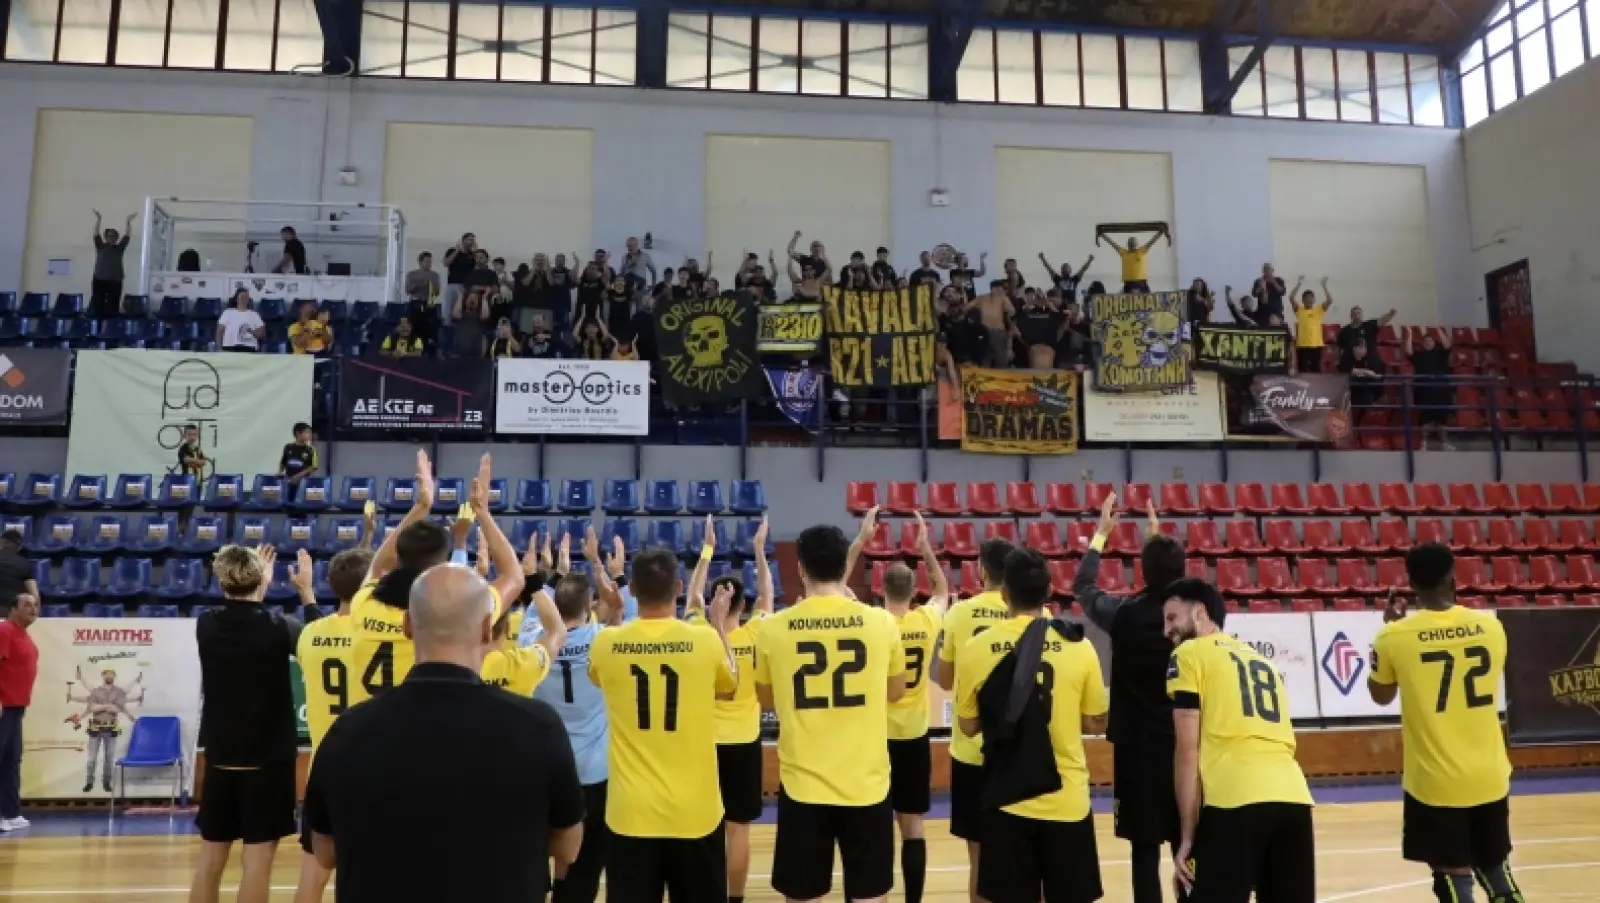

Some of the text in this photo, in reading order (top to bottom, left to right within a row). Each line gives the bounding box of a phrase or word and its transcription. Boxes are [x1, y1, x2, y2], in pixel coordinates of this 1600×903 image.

[660, 297, 746, 331] ORIGINAL
[504, 380, 641, 397] master optics
[788, 615, 864, 631] KOUKOULAS
[1418, 624, 1485, 642] CHICOLA
[362, 641, 394, 695] 4
[612, 641, 694, 655] PAPADIONYSIOU
[321, 657, 347, 716] 9
[559, 660, 574, 703] 1
[630, 663, 679, 731] 11
[794, 638, 867, 710] 22
[1229, 652, 1281, 723] 18
[1420, 645, 1493, 713] 72
